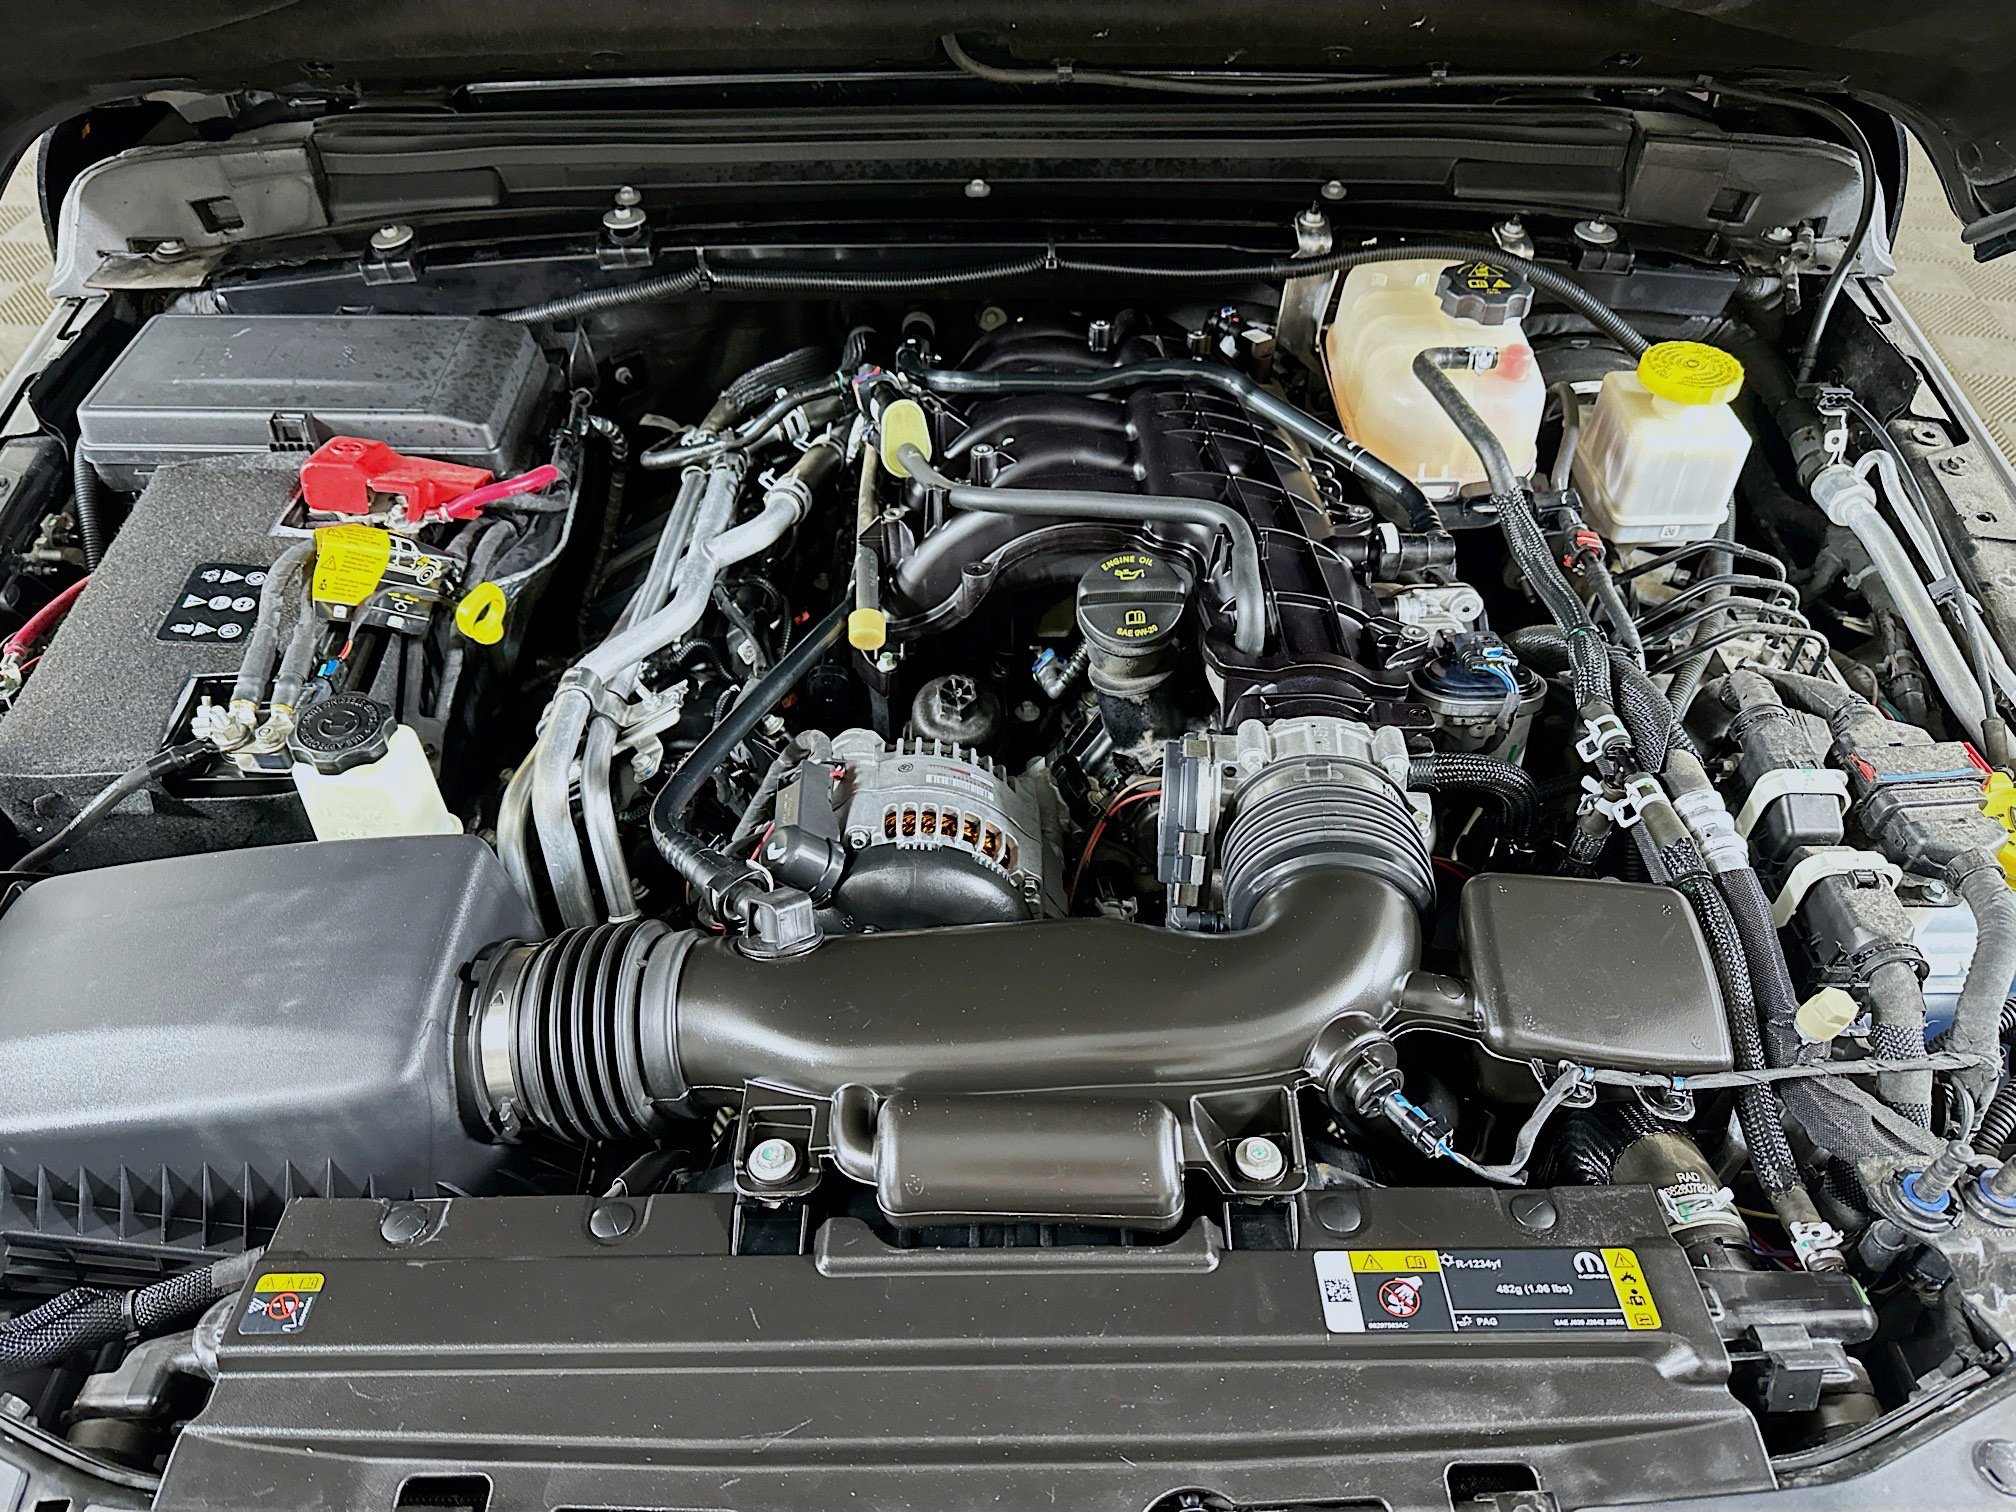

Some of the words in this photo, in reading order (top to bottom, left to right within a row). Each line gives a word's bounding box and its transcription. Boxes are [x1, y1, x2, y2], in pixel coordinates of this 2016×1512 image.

[1101, 555, 1135, 570] ENGINE
[1139, 556, 1153, 566] OIL
[1116, 627, 1134, 637] SAE
[1134, 624, 1158, 637] 0W-20
[1675, 1172, 1701, 1183] RAD
[1455, 1259, 1502, 1271] R-1234yf
[1524, 1283, 1551, 1296] (1.06
[1551, 1283, 1574, 1296] lbs)
[1476, 1316, 1499, 1327] PAG
[1553, 1318, 1570, 1326] SAE
